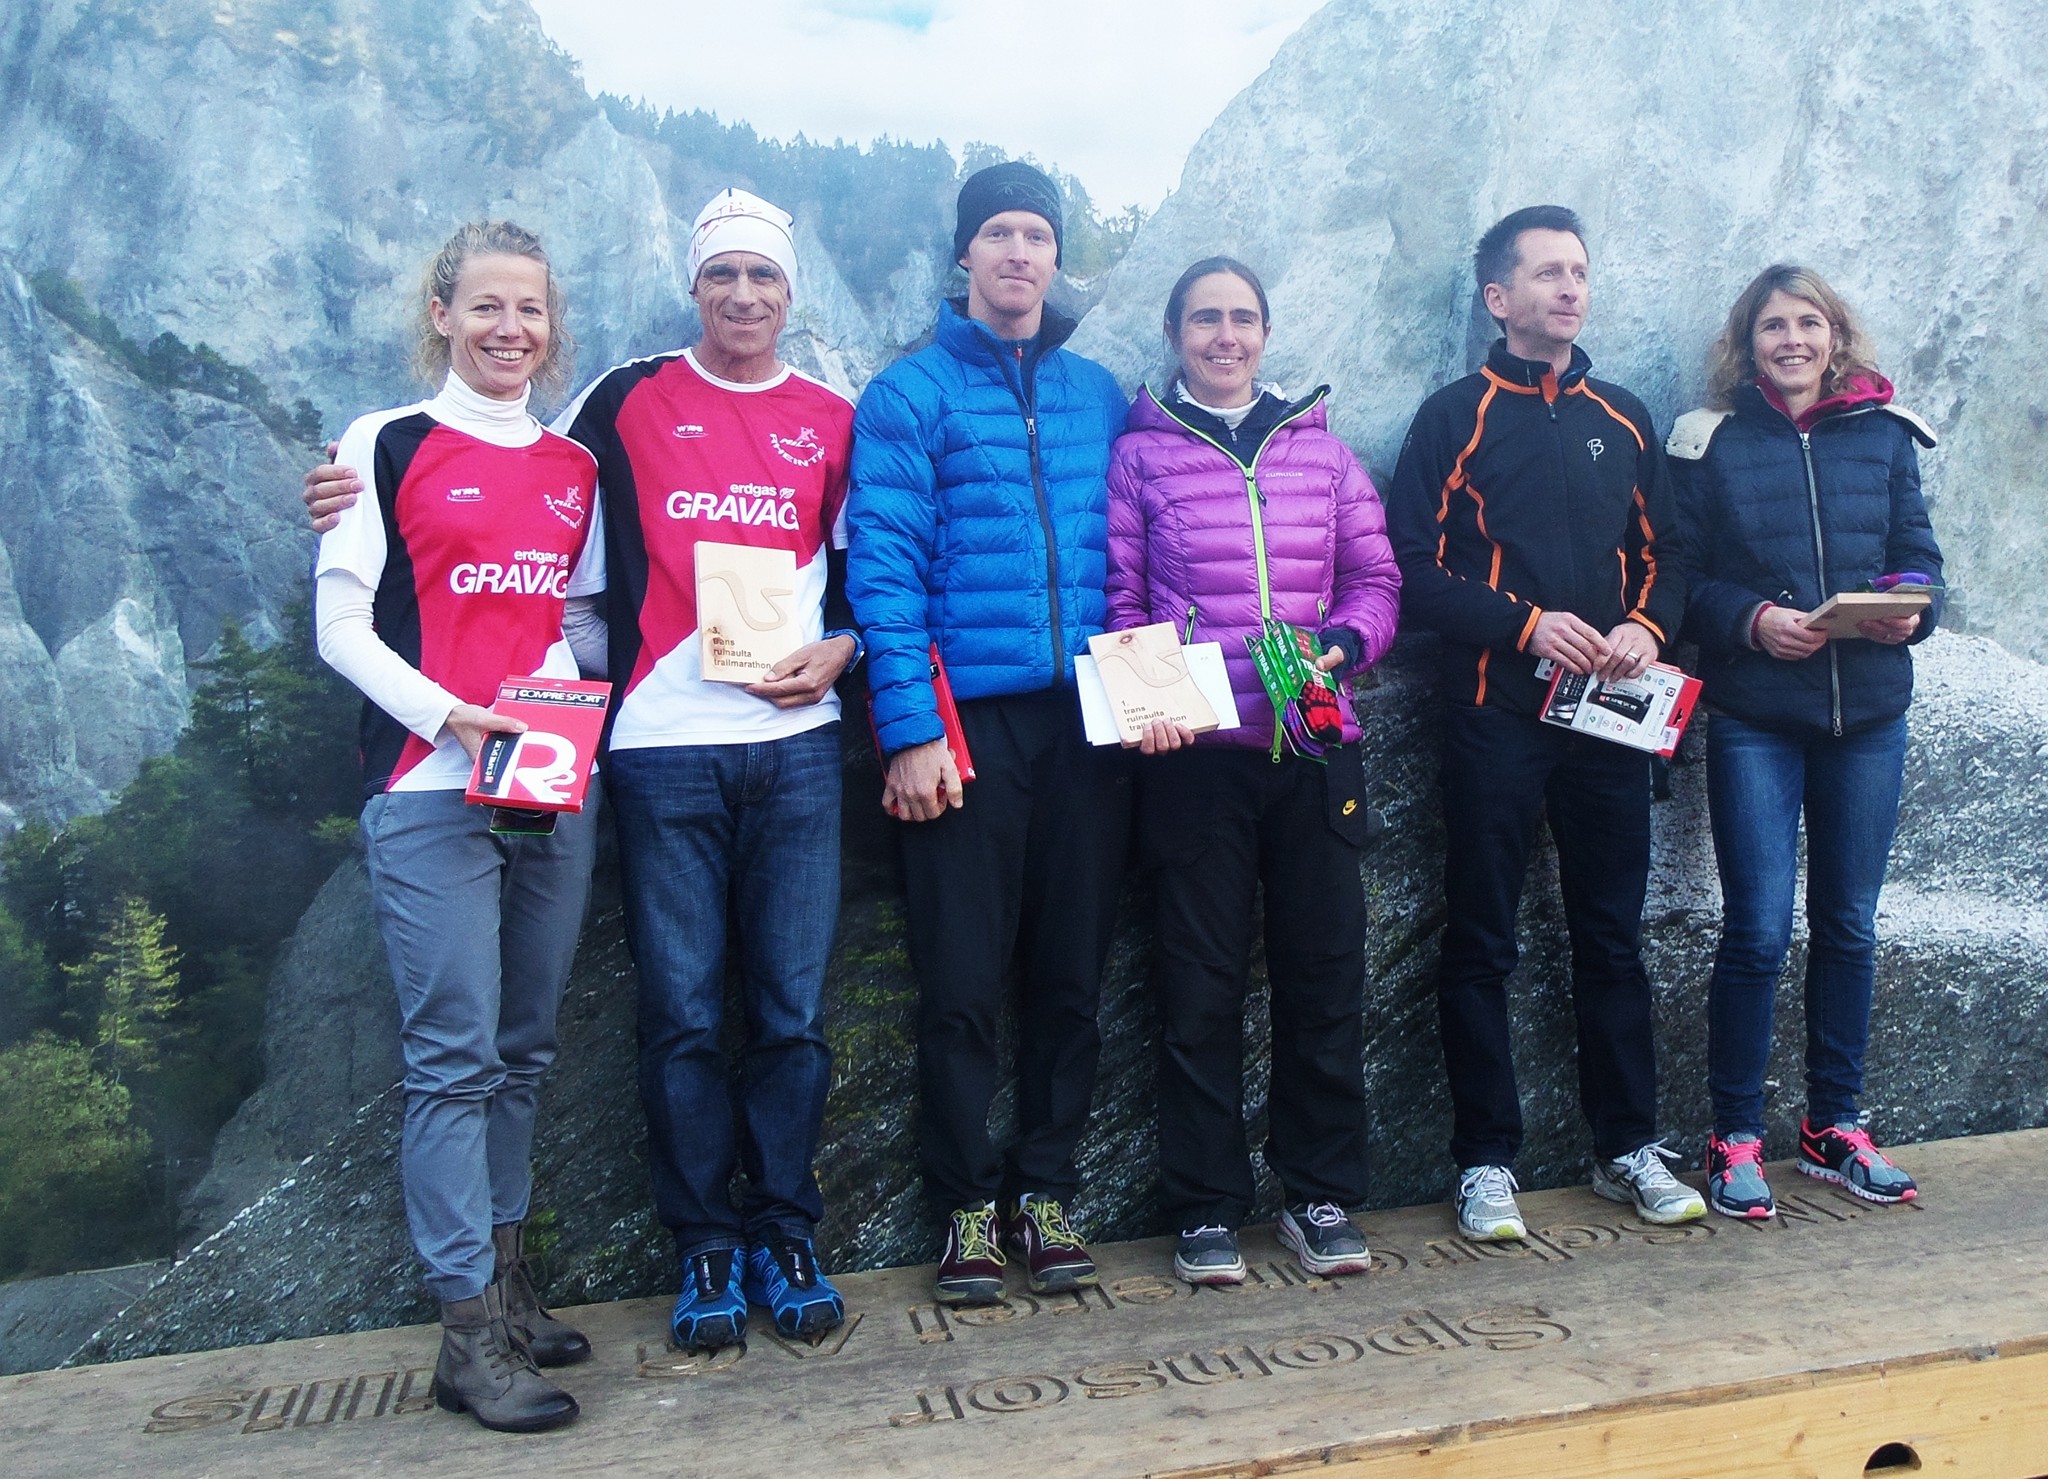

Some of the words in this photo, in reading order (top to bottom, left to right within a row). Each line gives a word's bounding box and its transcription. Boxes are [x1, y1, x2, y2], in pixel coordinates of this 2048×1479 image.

[730, 482, 777, 497] erdgas
[666, 490, 800, 530] GRAVAG
[514, 549, 558, 564] erdgas
[450, 563, 568, 599] GRAVAG
[713, 637, 735, 646] trans
[714, 658, 772, 669] trailmarathon
[1123, 706, 1146, 715] trans
[889, 1306, 1572, 1427] Sponsor
